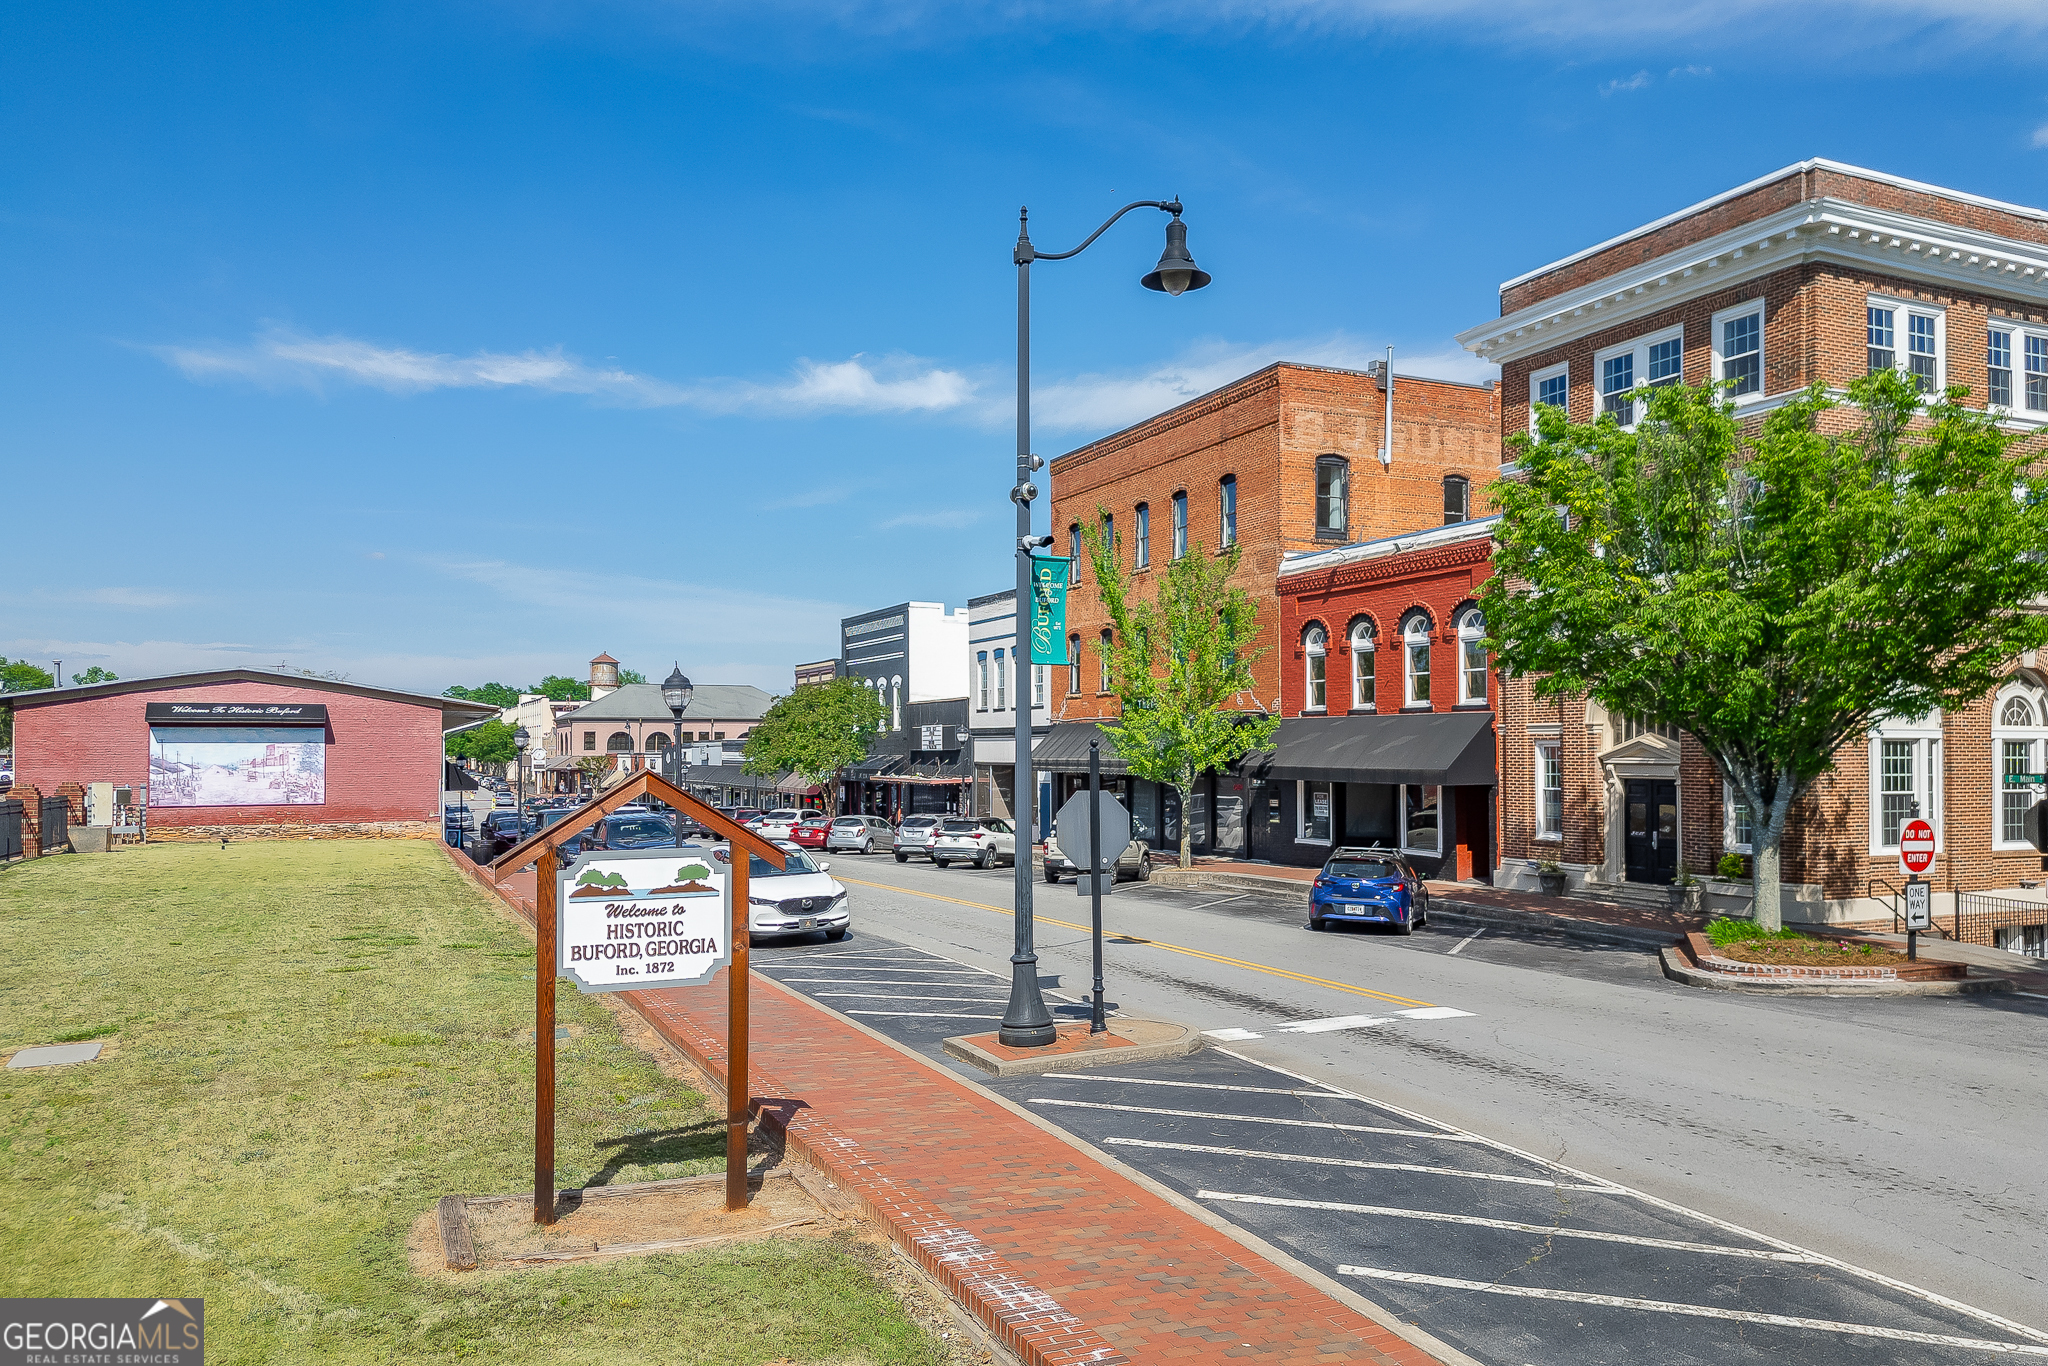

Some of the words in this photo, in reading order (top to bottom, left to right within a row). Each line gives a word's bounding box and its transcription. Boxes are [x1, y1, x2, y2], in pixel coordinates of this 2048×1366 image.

[265, 707, 302, 715] Buford
[1905, 830, 1915, 839] DO
[1918, 830, 1931, 839] NOT
[1907, 853, 1928, 863] ENTER
[1909, 888, 1924, 898] ONE
[1909, 900, 1925, 909] WAY
[605, 903, 668, 919] Welcome
[671, 903, 686, 916] to
[606, 920, 684, 940] HISTORIC
[570, 942, 643, 961] BUFORD,
[645, 938, 717, 957] GEORGIA
[615, 964, 639, 976] Inc.
[645, 961, 674, 974] 1872
